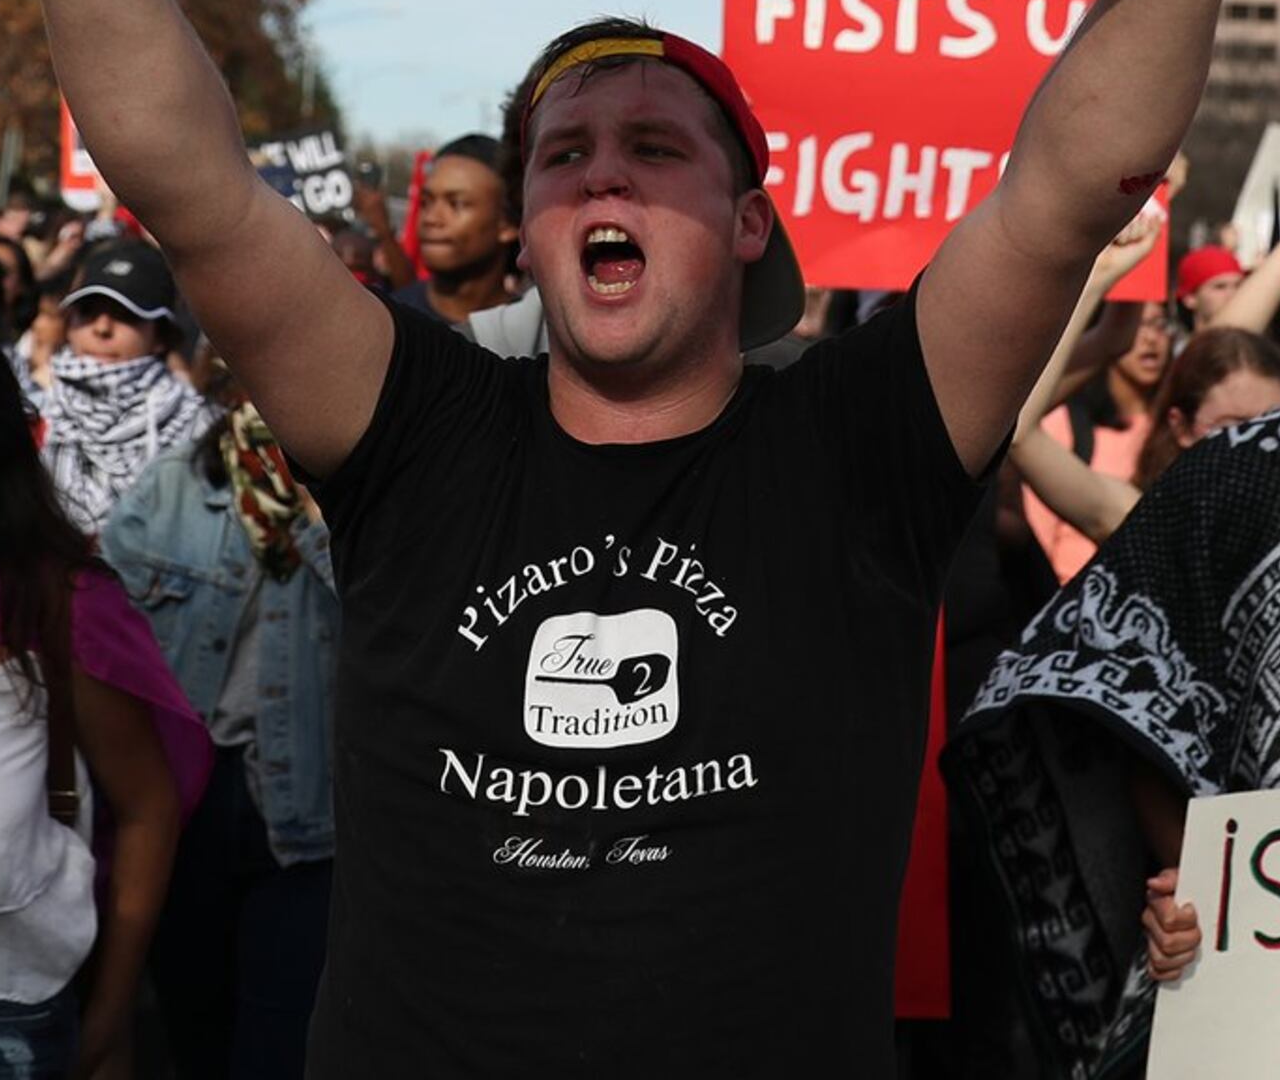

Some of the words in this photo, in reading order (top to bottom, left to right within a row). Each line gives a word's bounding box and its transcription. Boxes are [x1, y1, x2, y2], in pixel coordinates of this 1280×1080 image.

[763, 131, 1010, 223] FIGHT
[458, 535, 631, 652] Pizaro's
[642, 537, 738, 637] Pizza
[540, 633, 614, 676] True
[632, 662, 653, 696] 2
[529, 702, 670, 736] Tradition
[439, 748, 759, 816] Napoletana
